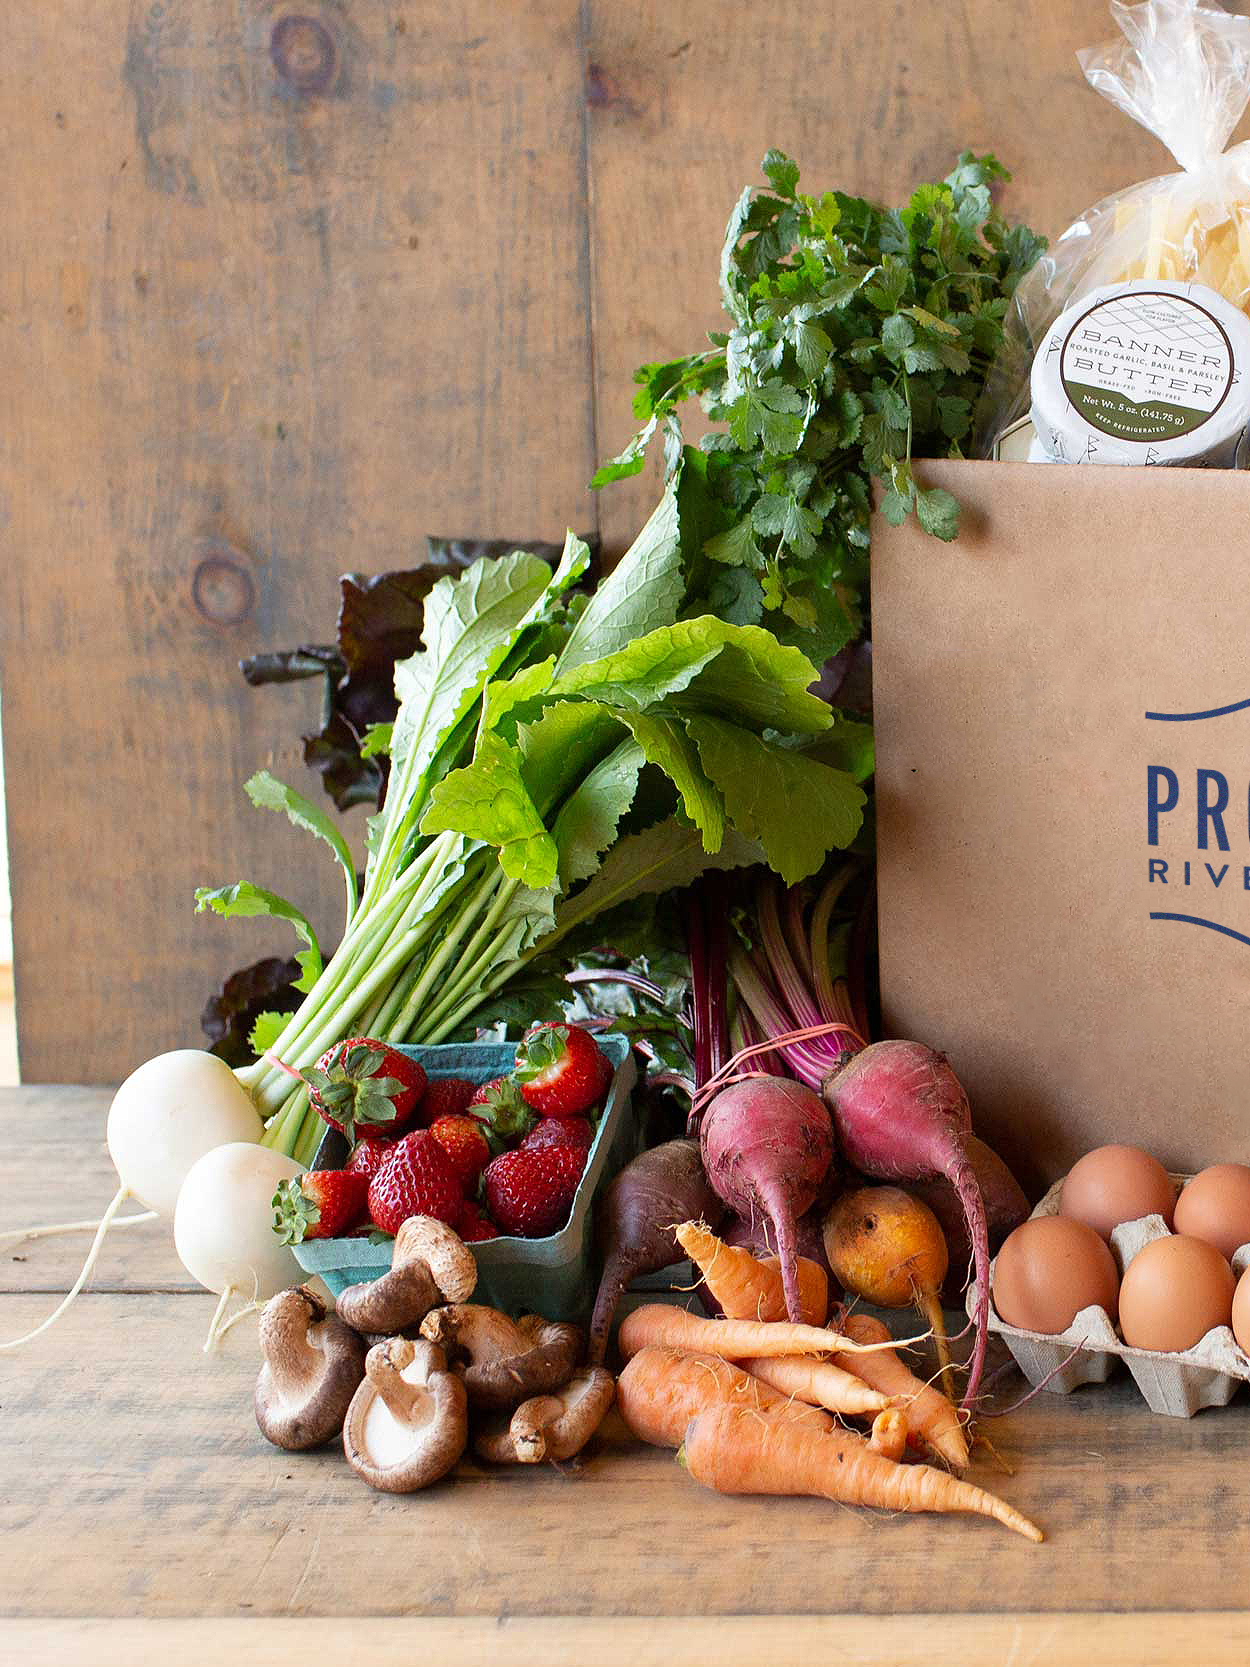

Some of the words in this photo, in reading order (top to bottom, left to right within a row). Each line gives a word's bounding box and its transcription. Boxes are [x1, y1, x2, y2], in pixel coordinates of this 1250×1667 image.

[1070, 343, 1110, 357] ROASTED
[1113, 353, 1147, 366] GARLIC,
[1151, 361, 1175, 371] BASIL
[1187, 368, 1225, 382] PARSLEY
[1081, 329, 1220, 368] BANNER
[1073, 358, 1213, 397] BUTTER
[1083, 394, 1098, 406] Net
[1101, 399, 1116, 410] Wt.
[1118, 403, 1124, 411] 5
[1125, 406, 1138, 414] oz.
[1140, 407, 1174, 422] (141.75
[1174, 415, 1185, 426] g)
[1095, 412, 1111, 424] KEEP
[1113, 423, 1165, 433] REFRIGERATED
